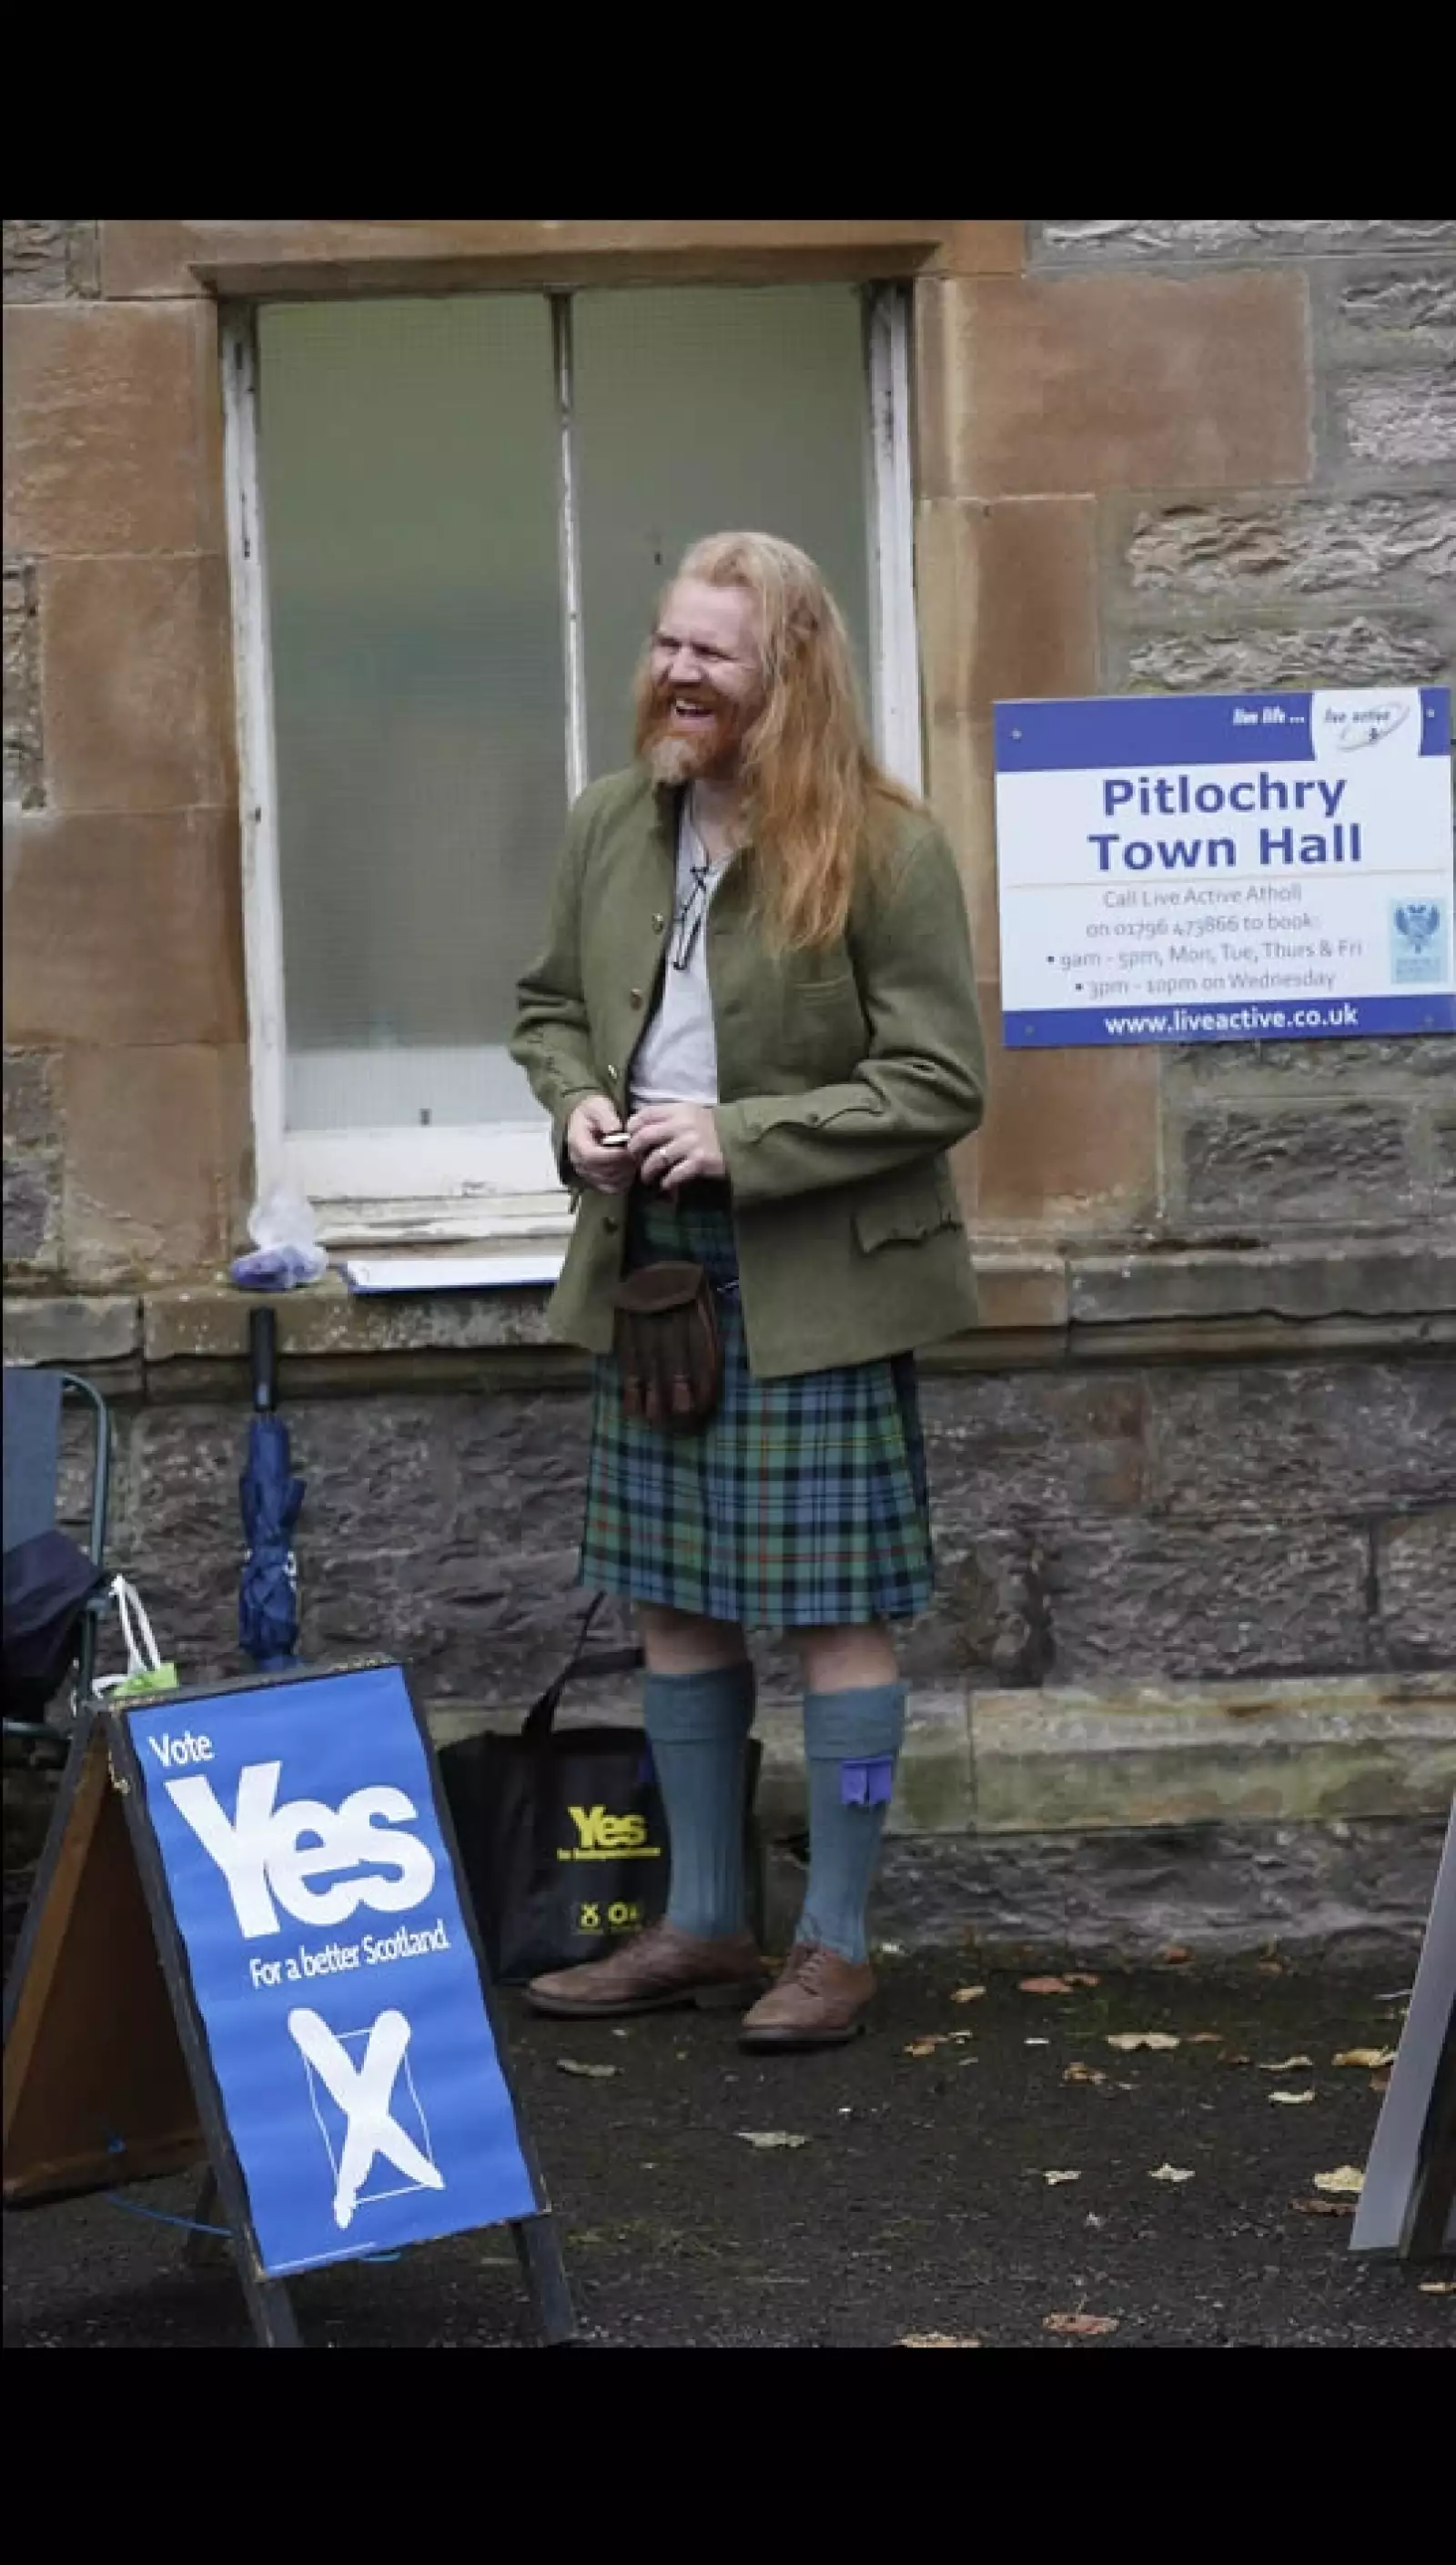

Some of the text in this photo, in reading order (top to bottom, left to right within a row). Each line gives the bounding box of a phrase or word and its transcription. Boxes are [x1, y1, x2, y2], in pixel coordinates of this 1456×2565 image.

[1102, 772, 1348, 818] Pitlochry
[1087, 823, 1361, 871] Town Hall
[1103, 888, 1137, 908] Call
[1142, 889, 1180, 907] Live
[1183, 887, 1241, 907] Active
[1086, 922, 1109, 938] on
[1243, 914, 1263, 931] to
[1060, 952, 1101, 972] 9am
[1221, 941, 1259, 964] Tue,
[1262, 939, 1316, 958] Thurs
[1320, 940, 1332, 958] &
[1337, 938, 1363, 957] Fri
[1201, 975, 1225, 990] on
[1227, 968, 1337, 991] Wednesday
[1103, 1002, 1360, 1036] www.liveactive.co.uk
[148, 1729, 217, 1769] Vote
[568, 1804, 648, 1849] Yes
[164, 1760, 436, 1940] Yes
[249, 1958, 282, 1990] For
[285, 1958, 302, 1981] a
[298, 1944, 361, 1978] better
